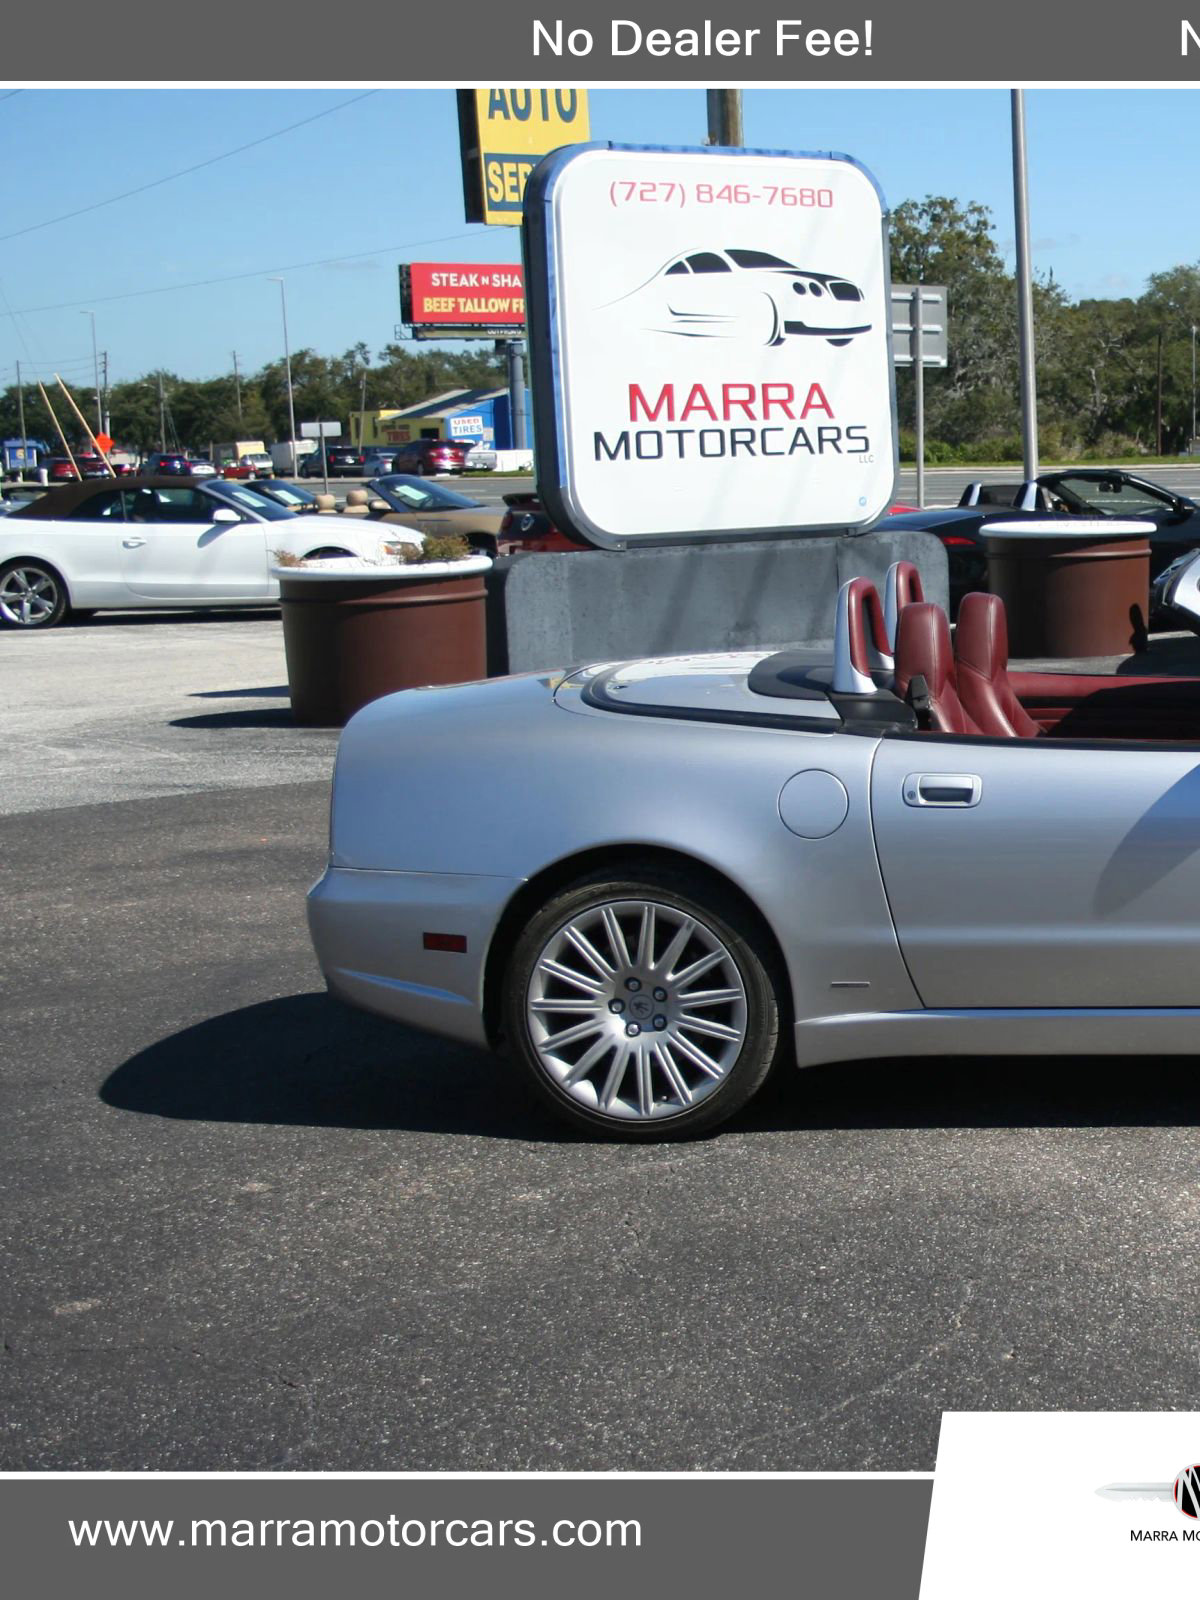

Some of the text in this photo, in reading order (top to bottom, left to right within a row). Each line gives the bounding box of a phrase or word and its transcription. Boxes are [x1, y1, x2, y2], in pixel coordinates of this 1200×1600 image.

[609, 181, 834, 209] (727) 846-7680
[431, 272, 479, 287] STEAK
[481, 276, 489, 286] N
[423, 296, 456, 313] BEEF
[457, 297, 511, 313] TALLOW
[628, 382, 835, 422] MARRA
[452, 425, 483, 435] TIRES
[593, 425, 870, 461] MOTORCARS
[858, 454, 874, 464] LLC
